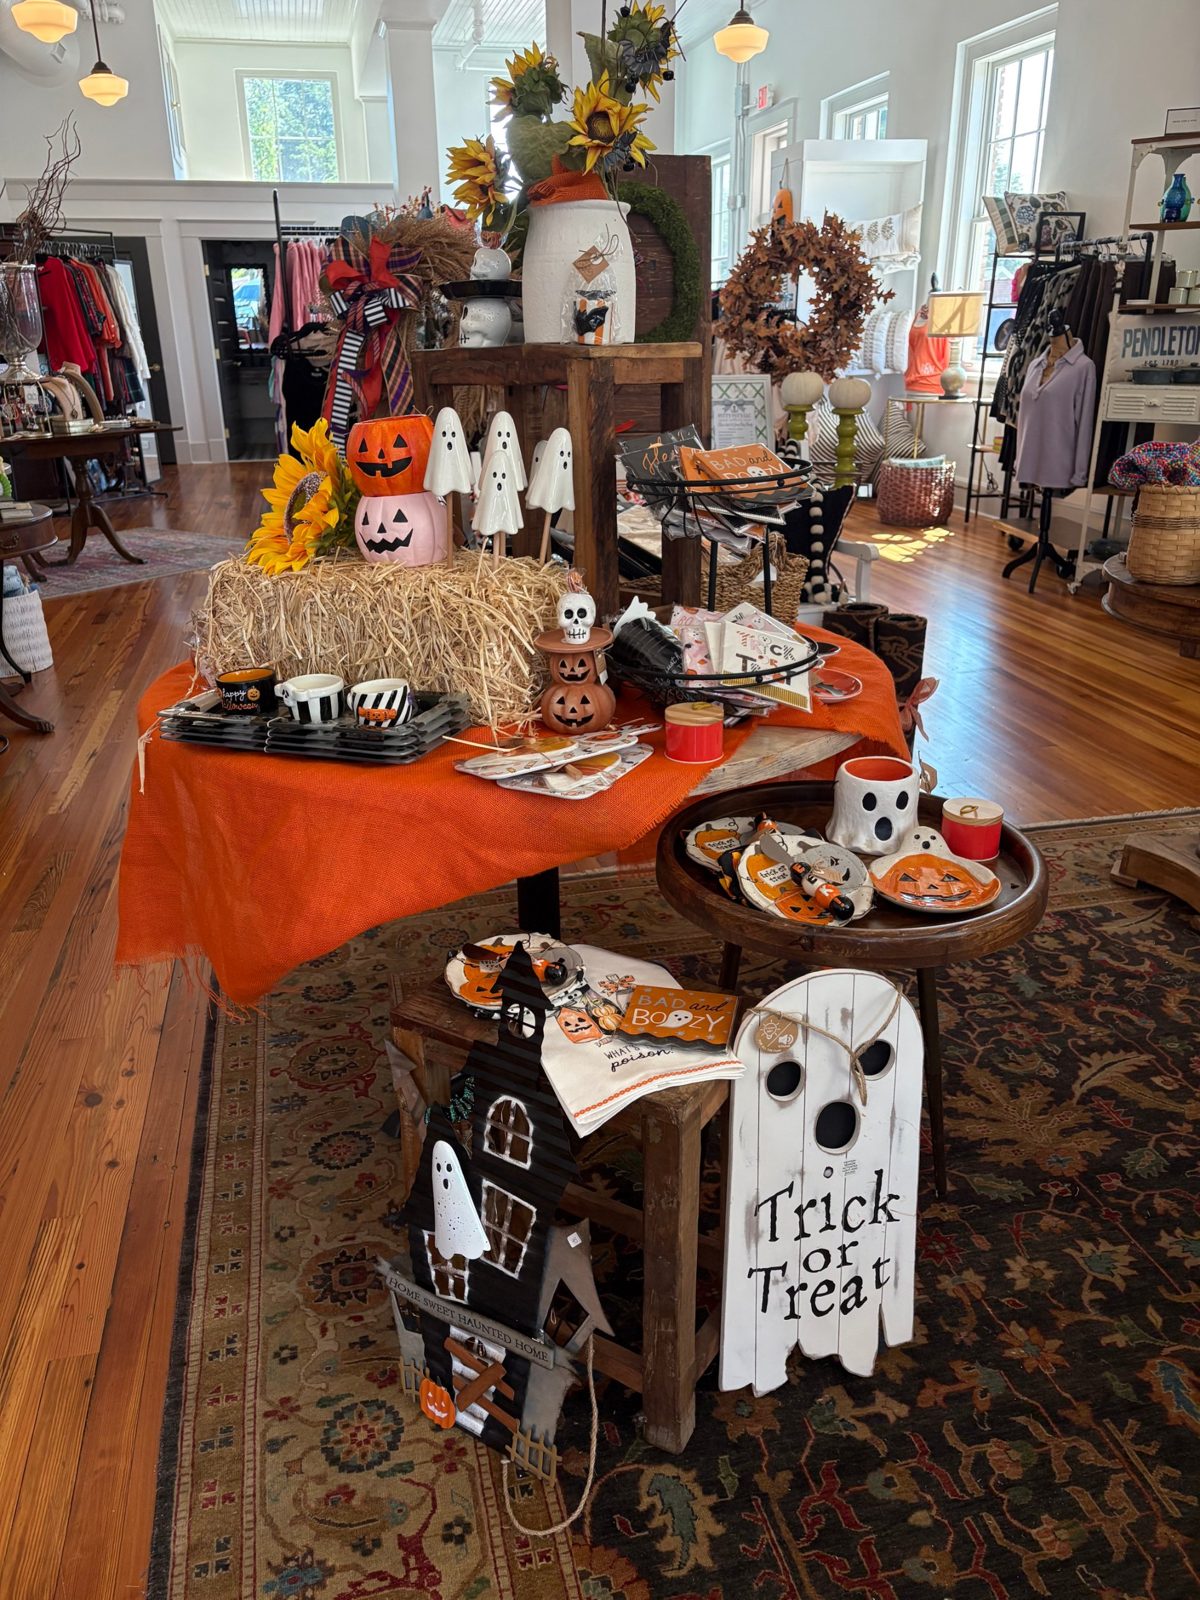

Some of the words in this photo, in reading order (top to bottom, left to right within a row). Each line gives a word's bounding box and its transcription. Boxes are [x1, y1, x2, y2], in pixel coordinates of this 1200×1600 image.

[712, 457, 746, 470] BAD
[749, 451, 773, 465] and
[759, 869, 778, 879] trick
[637, 994, 687, 1010] BAD
[688, 1000, 729, 1013] and
[754, 1168, 901, 1243] Trick
[802, 1240, 859, 1274] or
[747, 1256, 891, 1321] Treat
[388, 1276, 421, 1303] HOME
[423, 1297, 456, 1319] SWEET
[457, 1312, 512, 1345] HAUNTED
[514, 1340, 550, 1363] HOME
